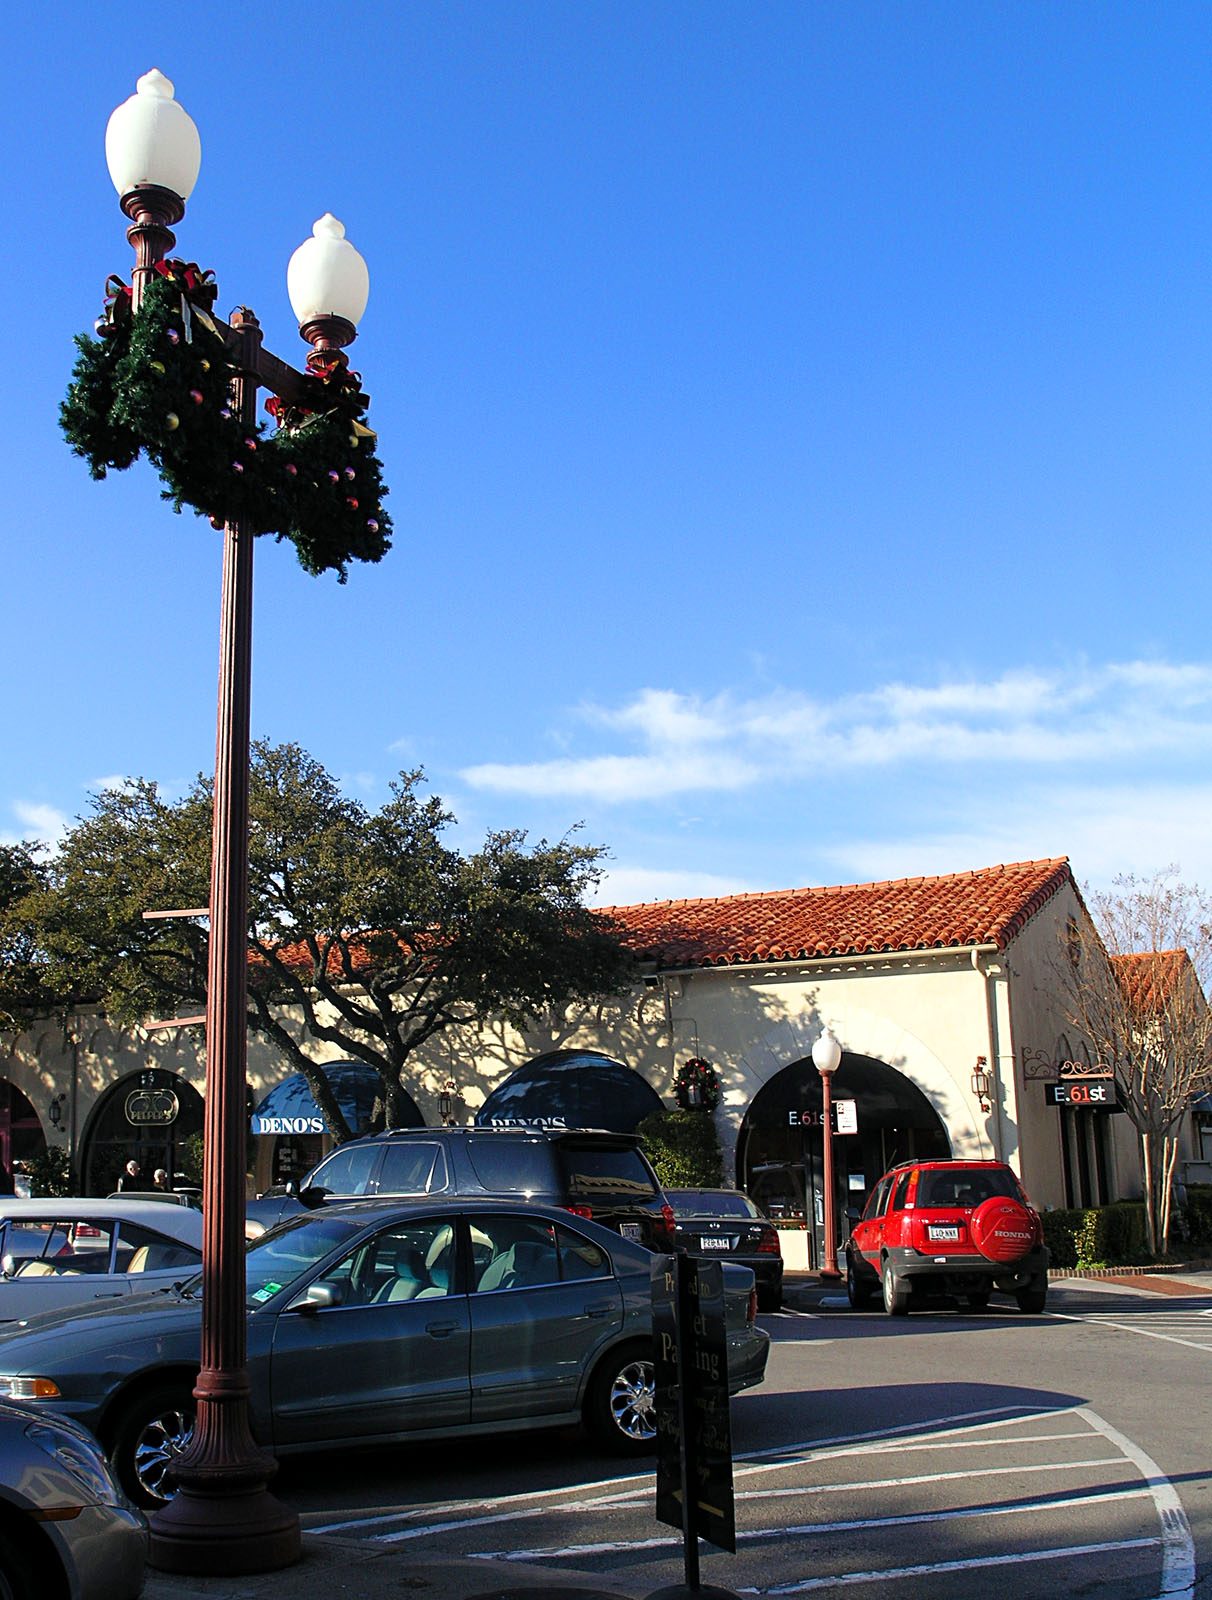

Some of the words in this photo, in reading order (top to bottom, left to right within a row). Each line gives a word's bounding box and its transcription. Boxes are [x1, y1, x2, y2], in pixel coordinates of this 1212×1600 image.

[1054, 1085, 1107, 1102] E.61st
[259, 1117, 324, 1133] DENO'S
[788, 1111, 834, 1125] E.61s
[994, 1230, 1032, 1239] HONDA
[661, 1332, 720, 1381] Paing
